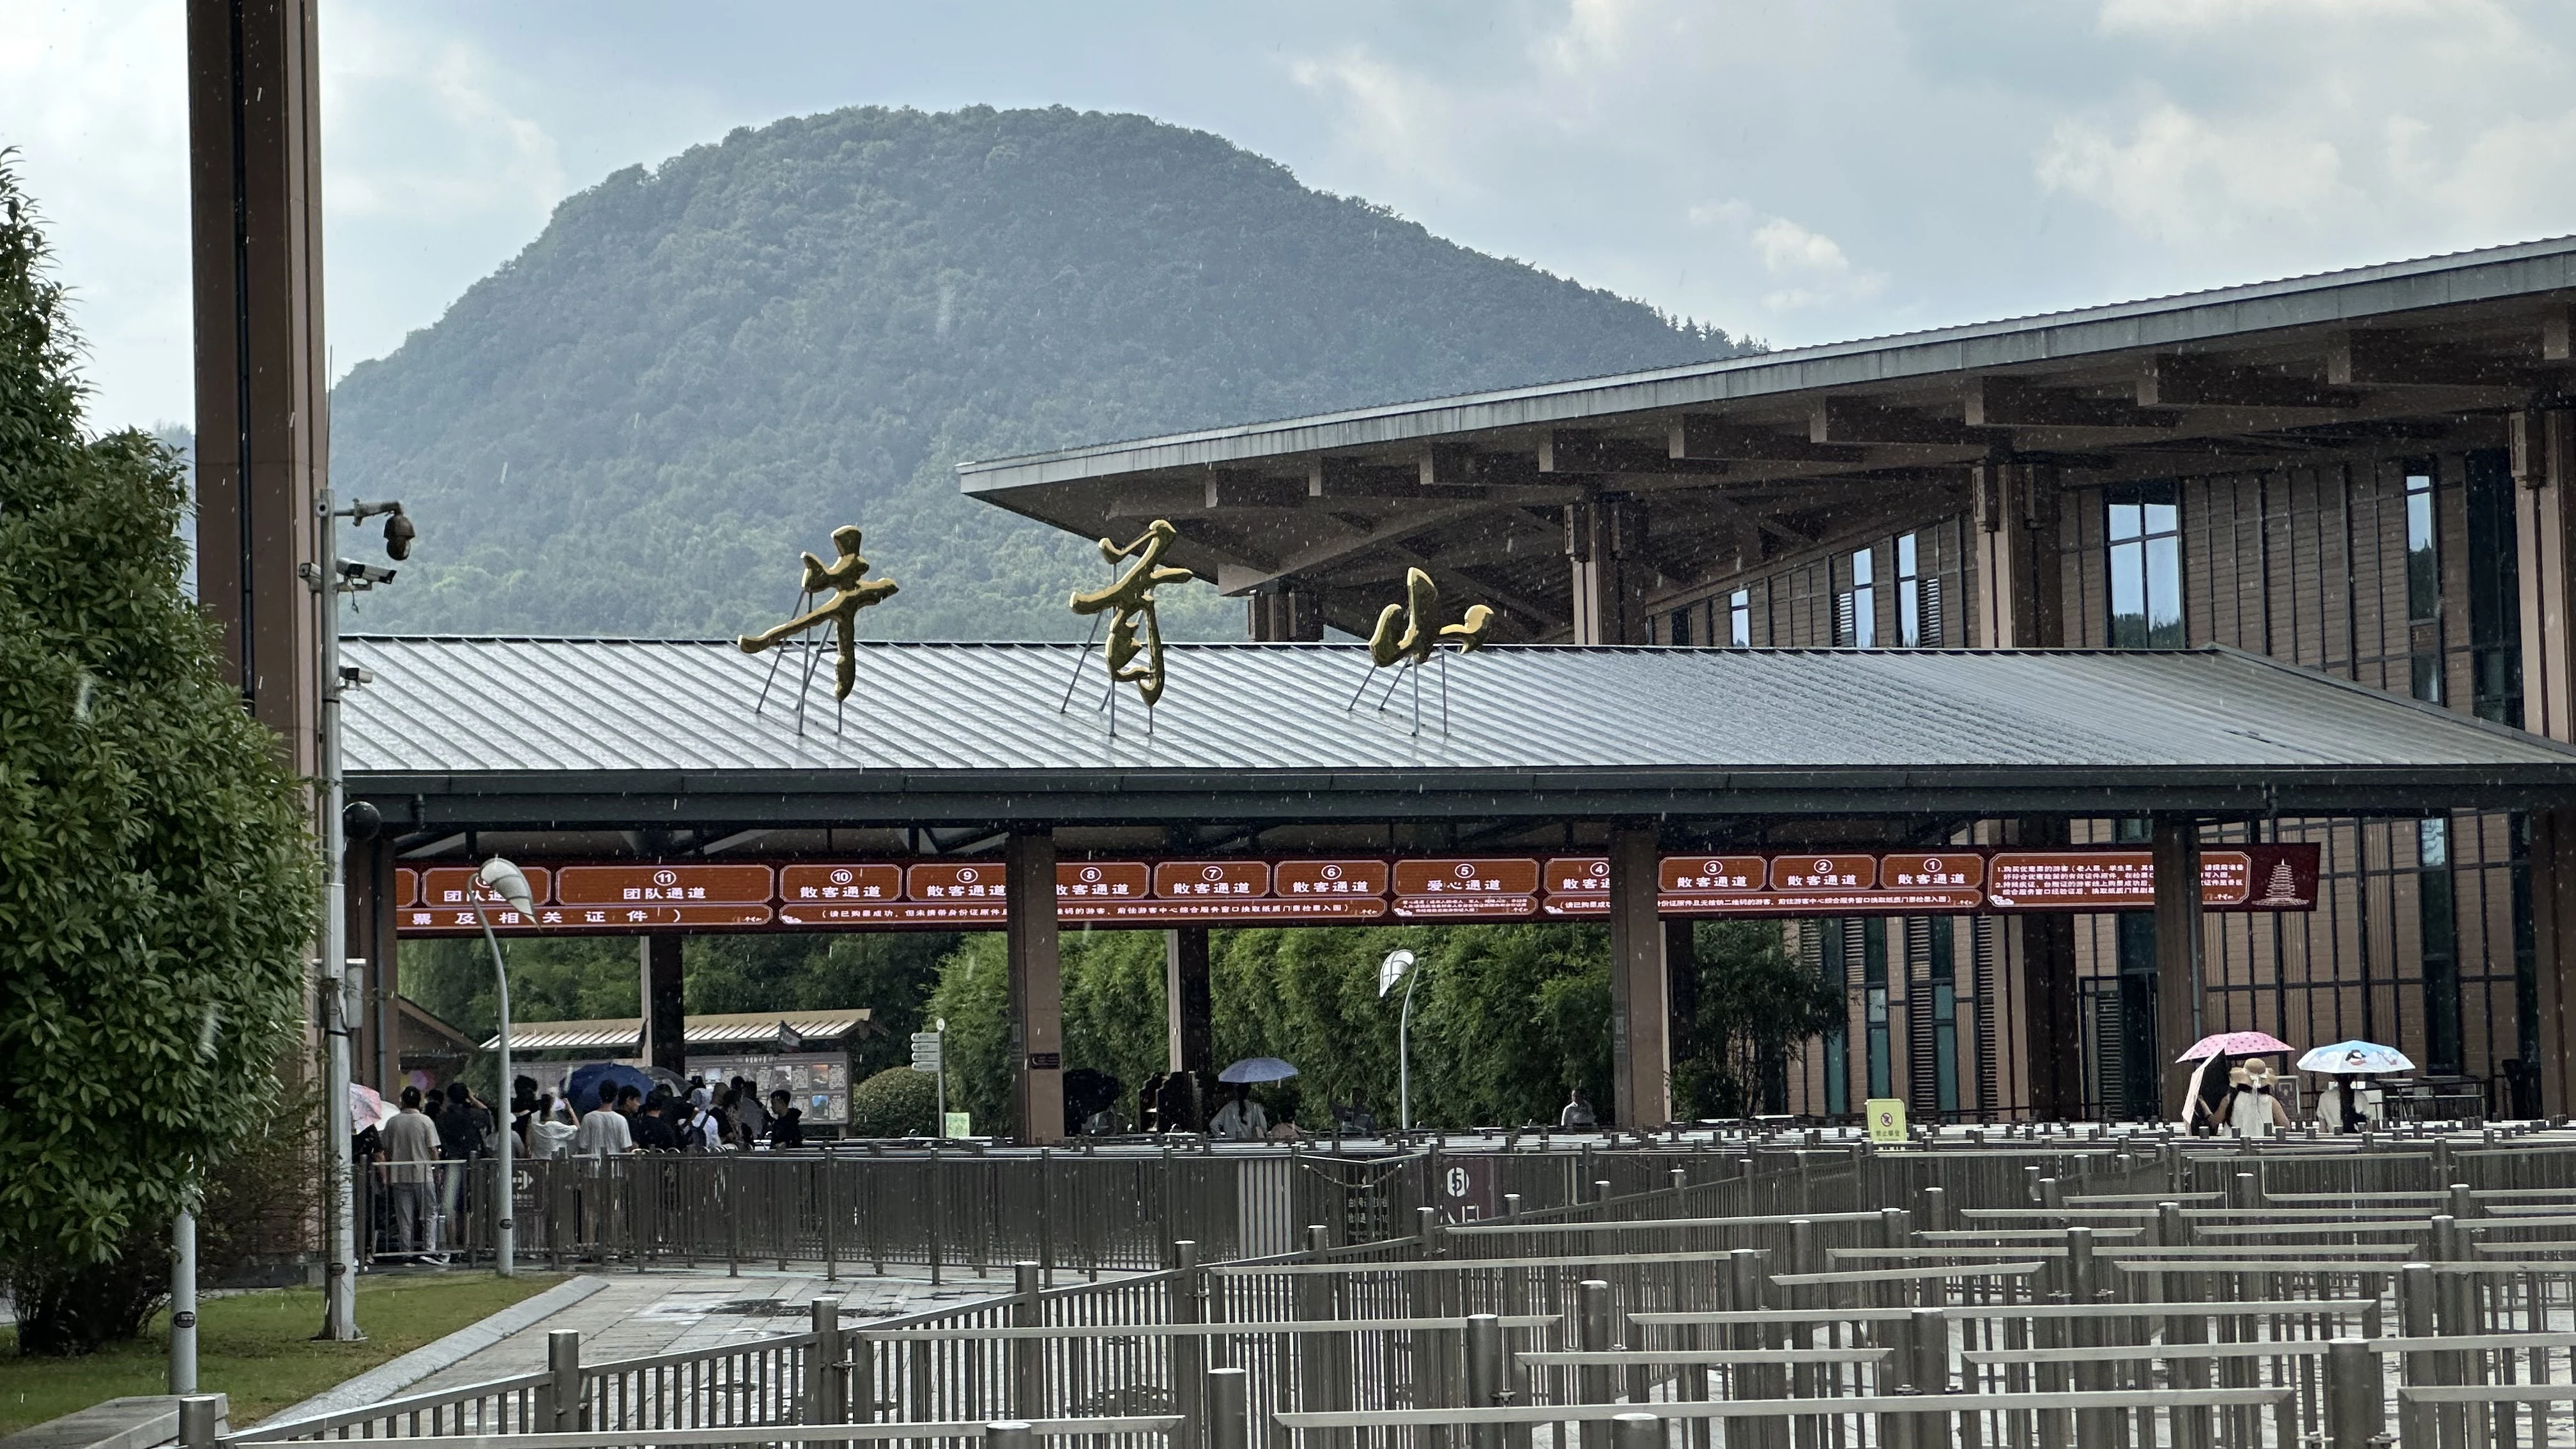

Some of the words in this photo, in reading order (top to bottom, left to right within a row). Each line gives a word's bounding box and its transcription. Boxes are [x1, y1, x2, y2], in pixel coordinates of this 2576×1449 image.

[739, 519, 1494, 707] 牛首山
[1677, 876, 1747, 887] 散客通道
[1788, 874, 1856, 886] 散客通道
[1898, 873, 1965, 884] 散客通道
[927, 885, 1006, 896] 散客通道
[1174, 882, 1250, 894] 散客通道
[1293, 881, 1368, 893] 散客通道
[1427, 879, 1501, 891] 爱心通道
[624, 887, 706, 900] 团队通道
[801, 885, 881, 898] 散客通道
[412, 907, 681, 926] 票及相关证件）
